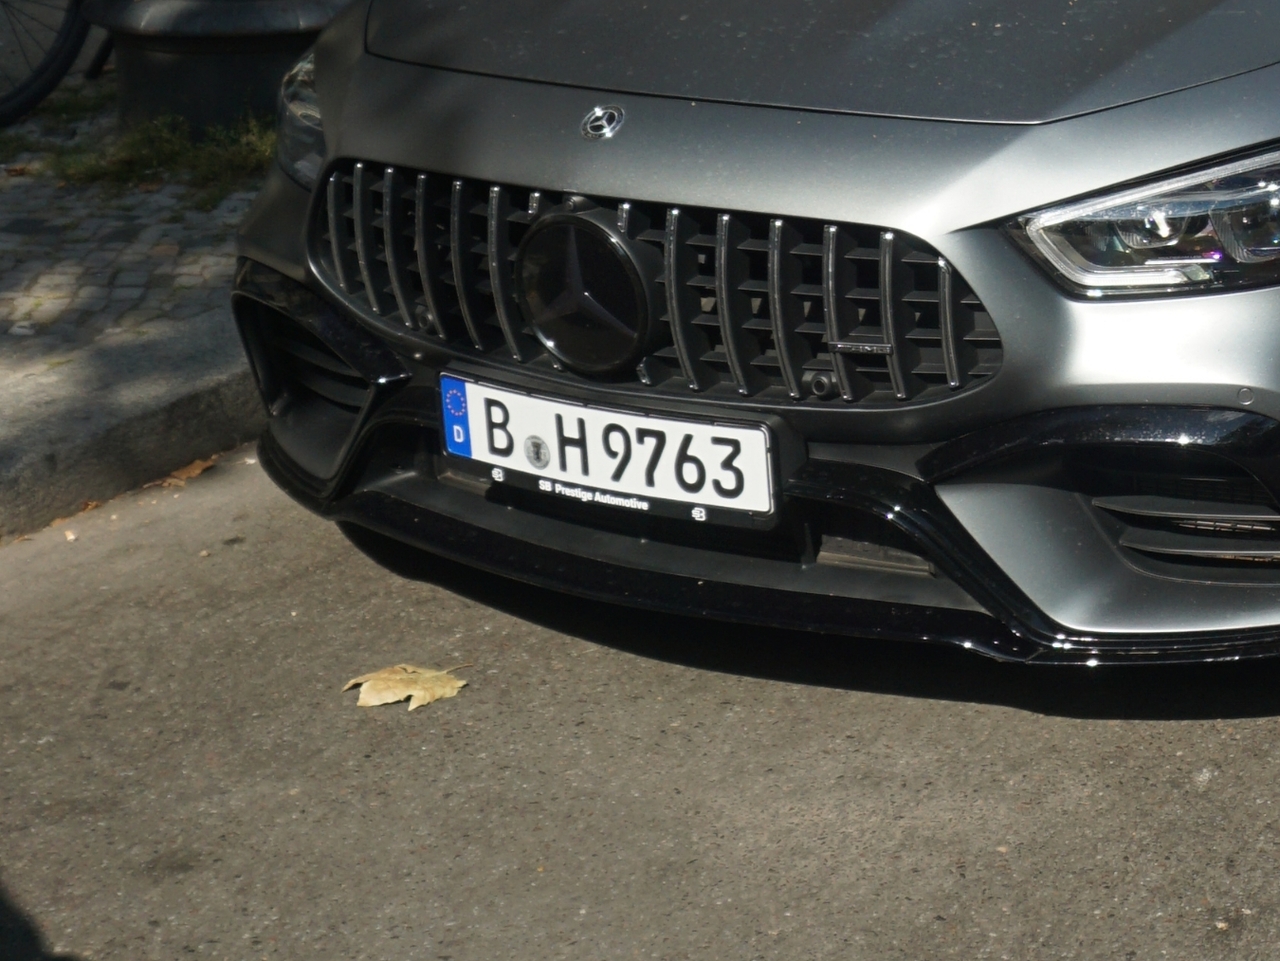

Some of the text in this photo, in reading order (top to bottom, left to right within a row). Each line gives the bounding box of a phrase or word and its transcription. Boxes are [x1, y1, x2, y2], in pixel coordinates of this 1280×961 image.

[452, 424, 465, 444] D
[483, 397, 514, 457] B
[538, 479, 649, 512] SB Prestige Automotive
